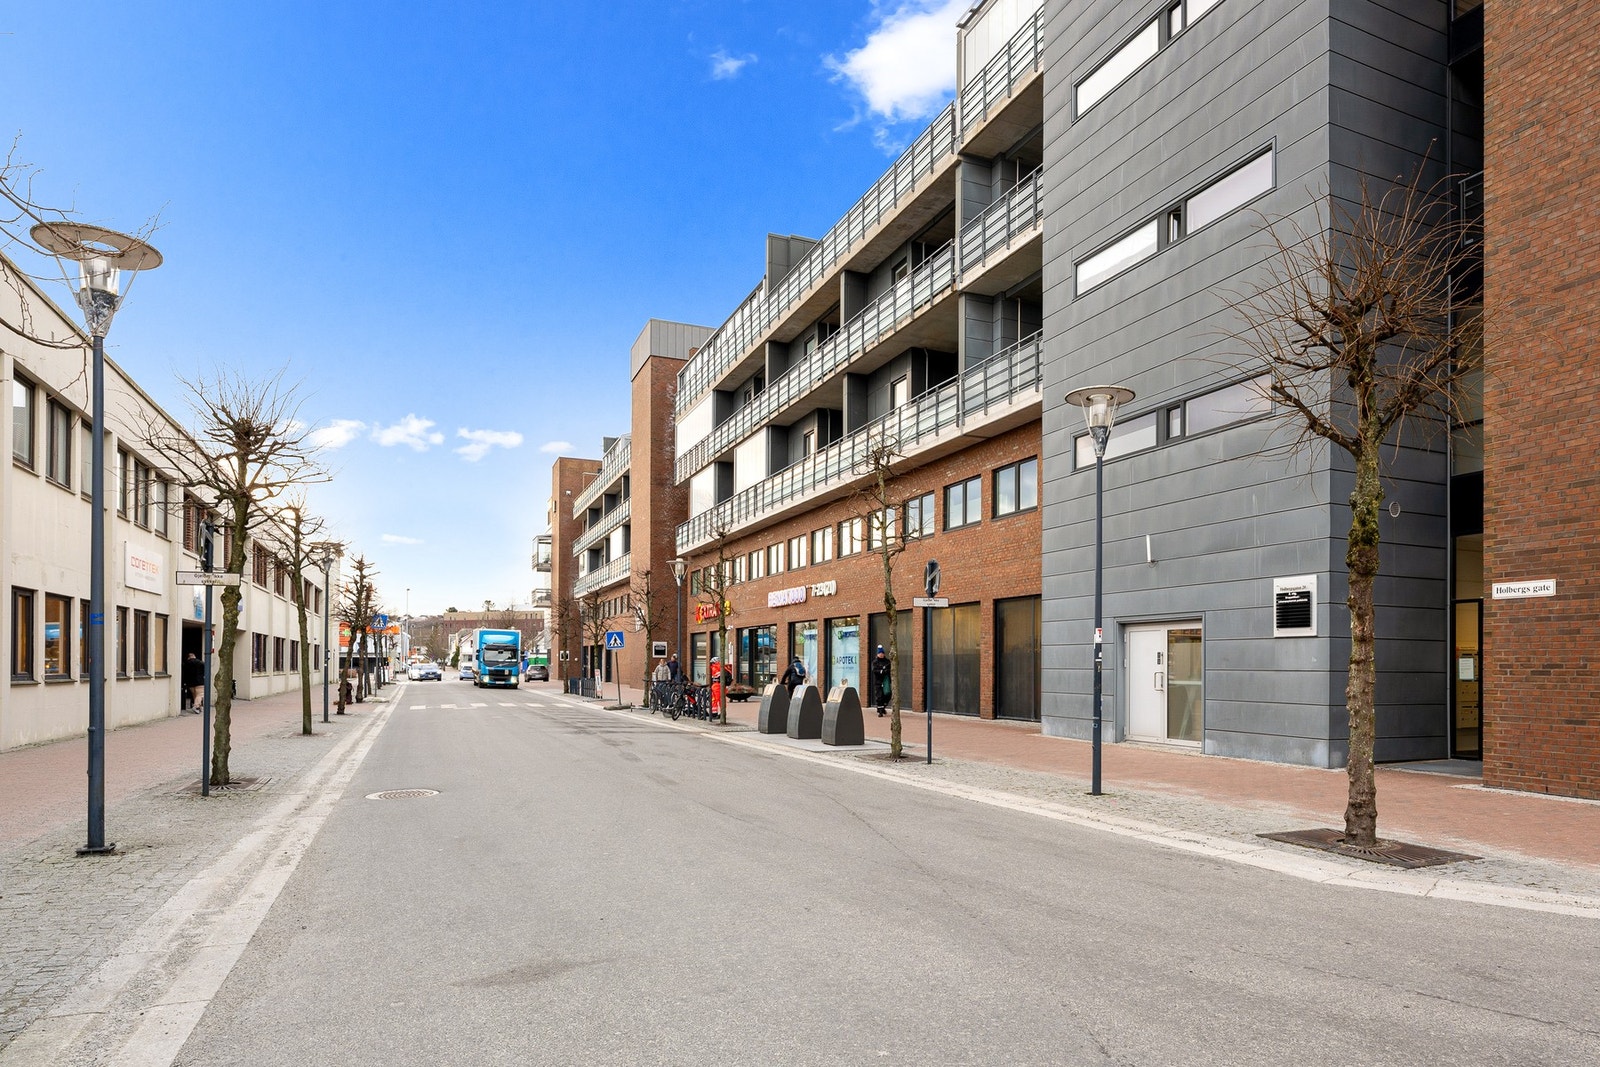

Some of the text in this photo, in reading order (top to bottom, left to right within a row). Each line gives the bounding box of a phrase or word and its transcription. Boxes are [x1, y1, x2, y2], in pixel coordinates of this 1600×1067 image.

[1496, 584, 1551, 594] Holbergs gate
[837, 656, 854, 664] APOTEK
